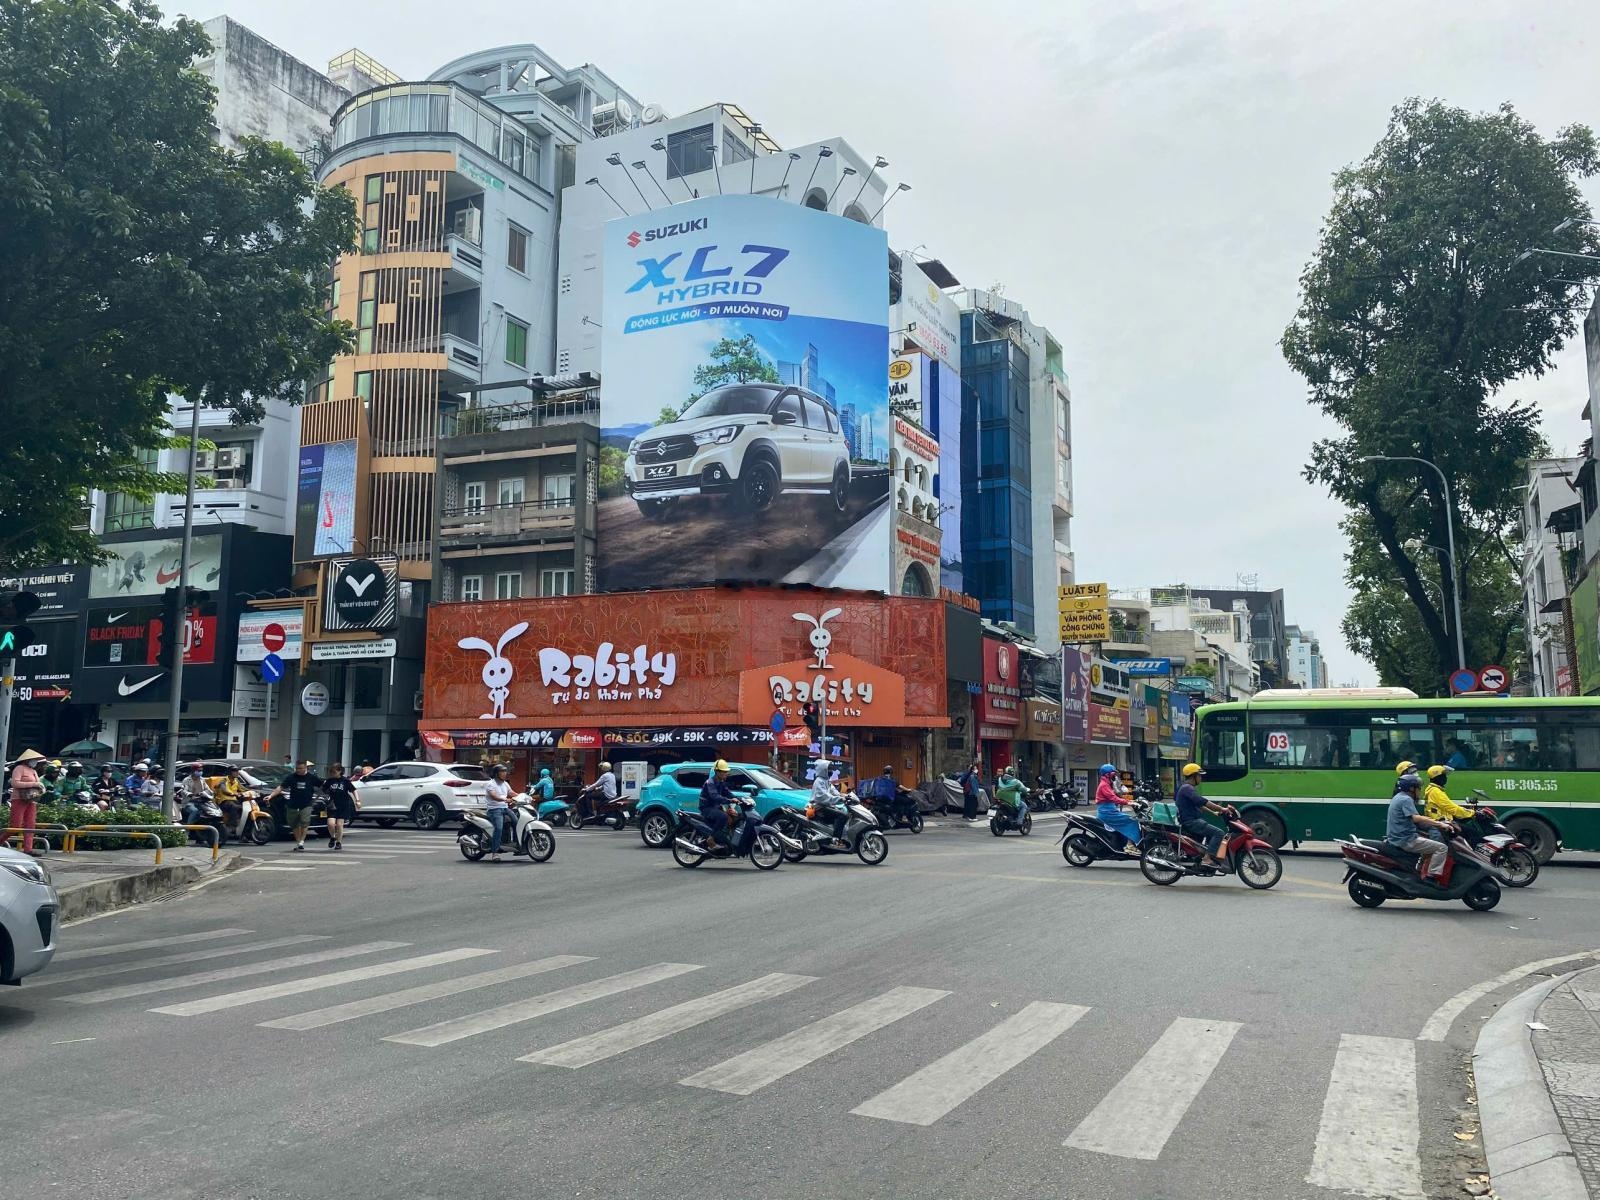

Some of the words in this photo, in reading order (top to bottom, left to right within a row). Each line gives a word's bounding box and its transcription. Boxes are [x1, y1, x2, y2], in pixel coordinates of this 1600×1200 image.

[645, 217, 708, 242] SUZUKI
[625, 244, 790, 294] XL7
[657, 281, 762, 305] HYBRID
[630, 316, 659, 330] ĐỘNG
[661, 313, 680, 326] LỰC
[681, 308, 701, 322] MỚI
[709, 306, 720, 316] ĐI
[723, 303, 759, 315] MUÔN
[762, 306, 783, 319] NƠI
[889, 381, 908, 397] VĂN
[647, 466, 674, 476] XL7
[57, 572, 76, 585] VIỆT
[1063, 585, 1085, 597] LUẬT
[1088, 584, 1101, 594] SƯ
[1064, 614, 1078, 622] VĂN
[1079, 613, 1102, 622] PHÒNG
[90, 626, 116, 640] BLACK
[117, 625, 145, 640] FRIDAY
[1062, 623, 1080, 631] CÔNG
[1082, 622, 1105, 631] CHỨNG
[538, 642, 677, 688] Rabity
[20, 687, 32, 701] 50
[768, 675, 873, 704] Rabity
[604, 731, 624, 743] GIÁ
[626, 731, 649, 743] SỐC
[652, 732, 673, 743] 49K
[683, 732, 705, 742] 59K
[716, 732, 739, 742] 69K
[752, 731, 775, 742] 79K
[1269, 735, 1288, 749] 03
[1494, 778, 1558, 792] 51B-305.55
